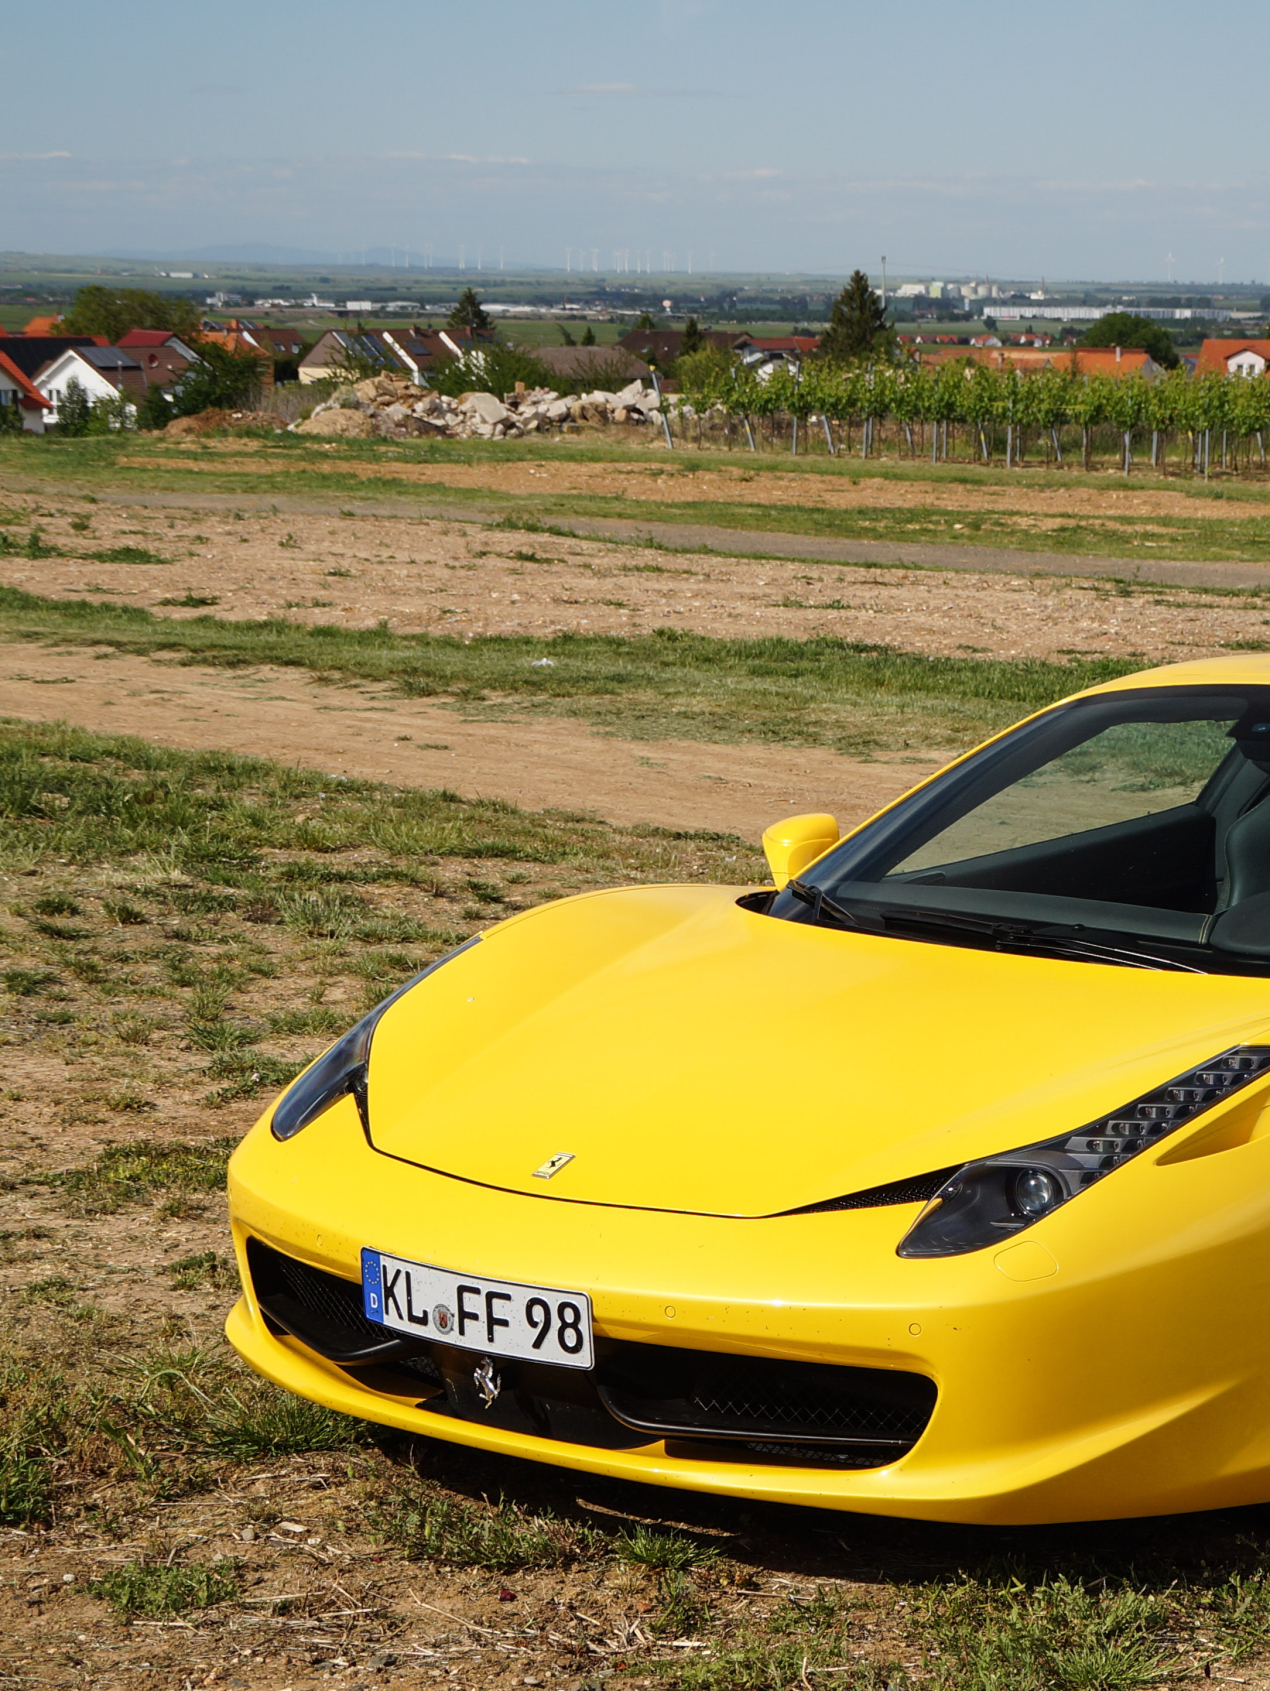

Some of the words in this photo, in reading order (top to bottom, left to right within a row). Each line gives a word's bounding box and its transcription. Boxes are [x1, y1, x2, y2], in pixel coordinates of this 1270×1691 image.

[370, 1292, 378, 1309] D
[382, 1264, 428, 1326] KL
[457, 1285, 512, 1343] FF
[525, 1297, 583, 1354] 98
